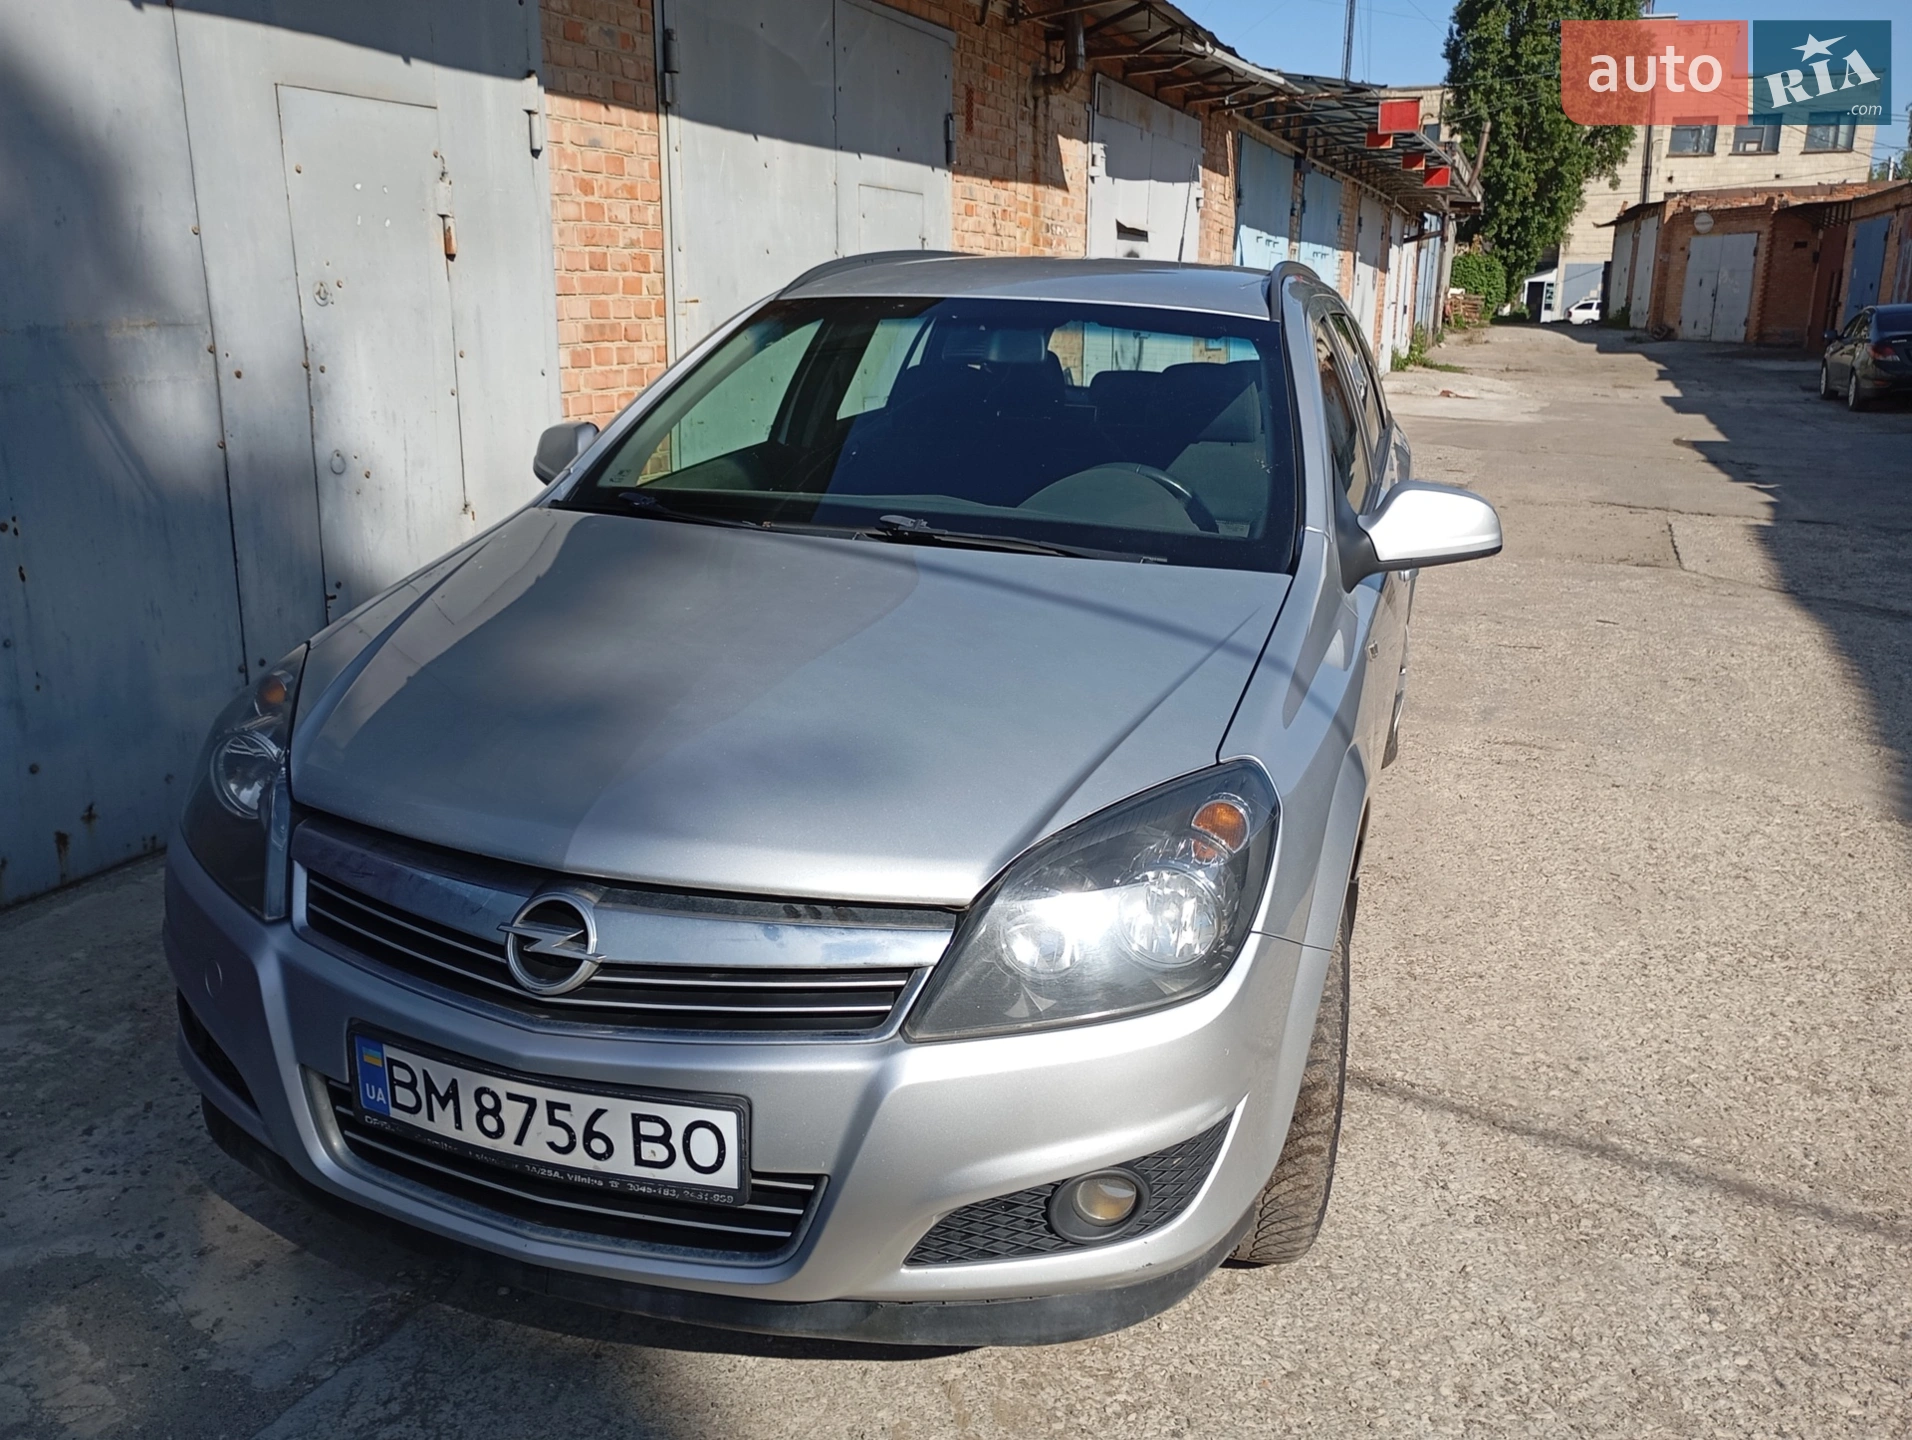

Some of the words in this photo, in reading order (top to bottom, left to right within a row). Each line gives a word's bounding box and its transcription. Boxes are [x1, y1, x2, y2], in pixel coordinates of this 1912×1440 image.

[365, 1082, 387, 1105] UA
[386, 1056, 464, 1132] BM
[473, 1086, 615, 1161] 8756
[630, 1112, 727, 1176] BO
